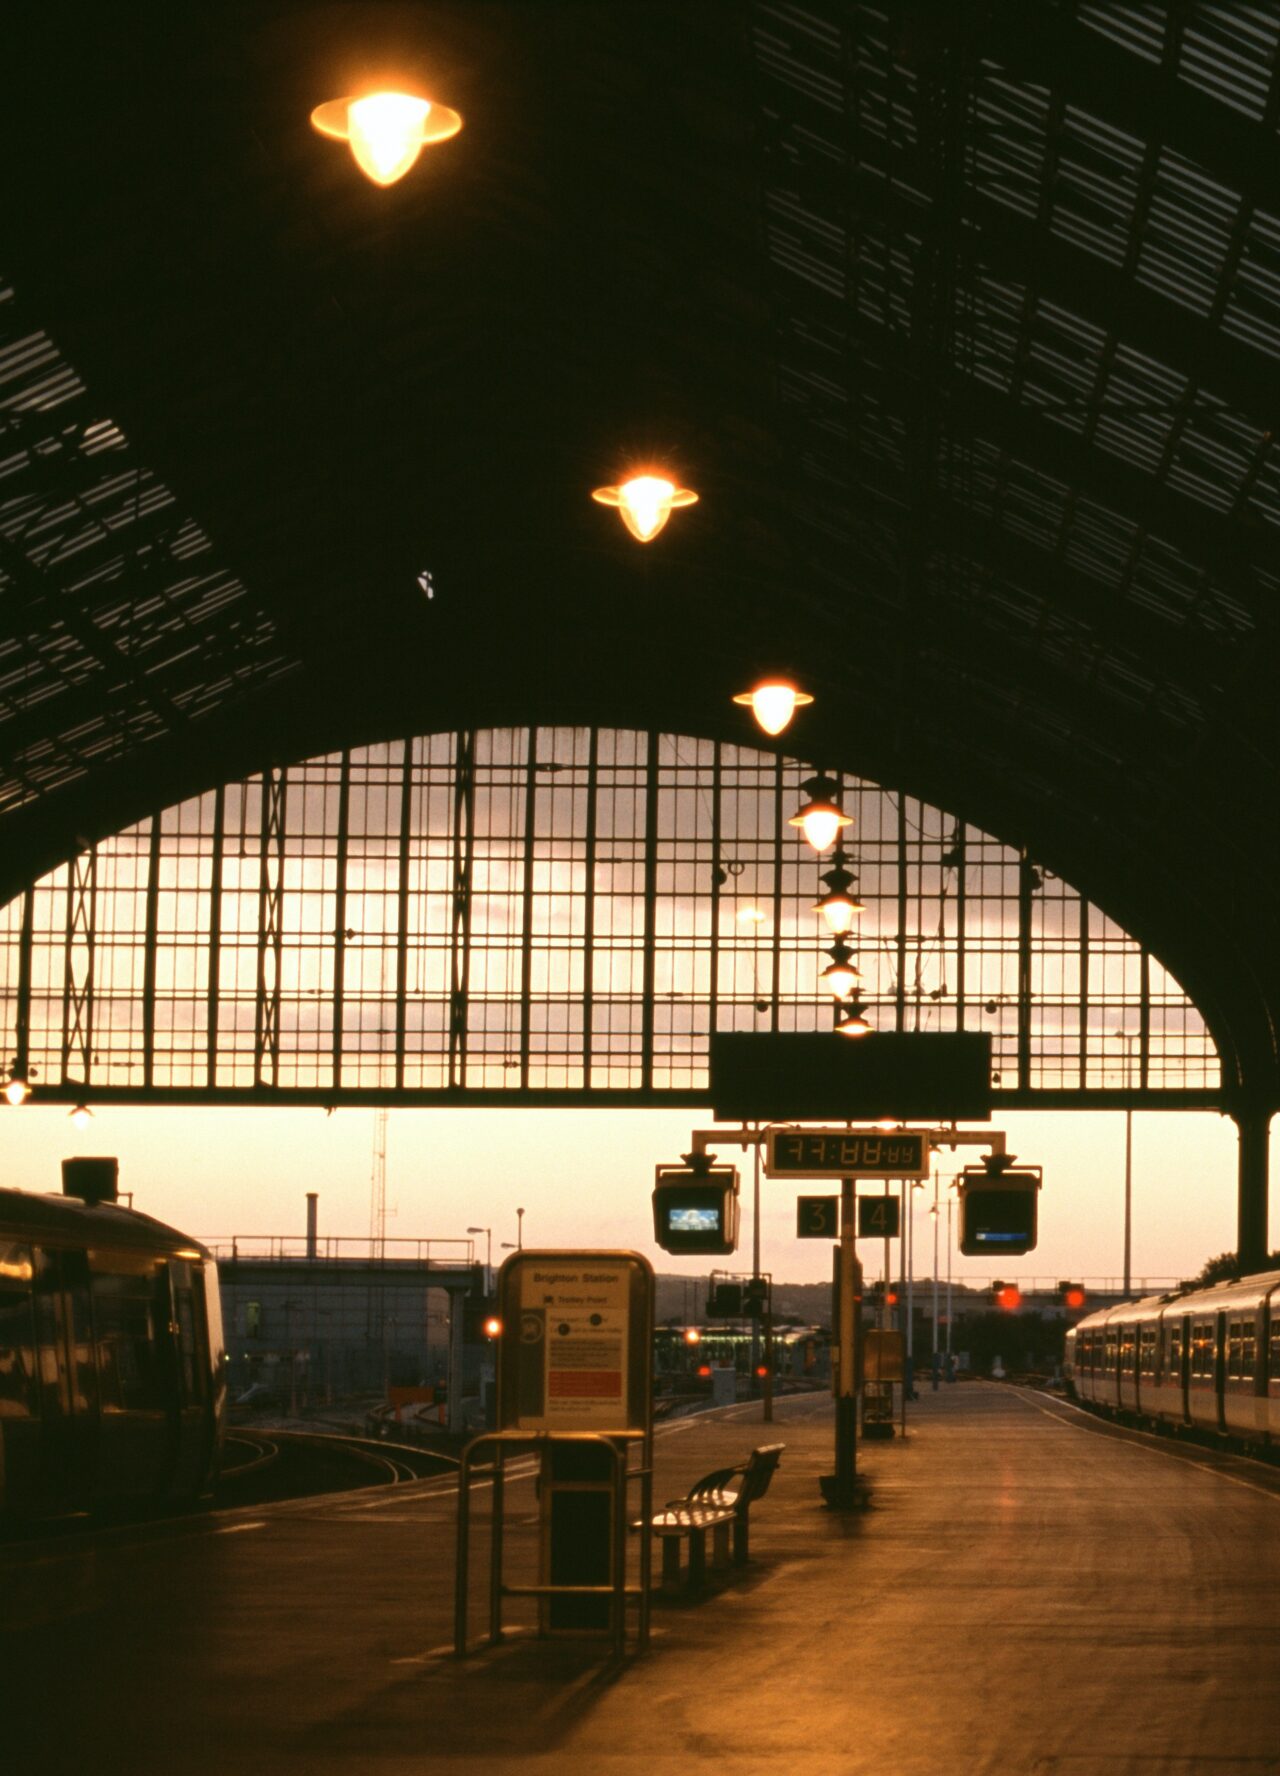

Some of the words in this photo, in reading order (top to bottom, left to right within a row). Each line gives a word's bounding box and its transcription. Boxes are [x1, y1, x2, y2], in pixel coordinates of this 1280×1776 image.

[809, 1203, 827, 1232] 3
[869, 1203, 888, 1231] 4
[533, 1273, 578, 1285] Brighton
[583, 1273, 619, 1283] Station
[558, 1295, 585, 1304] Trolley
